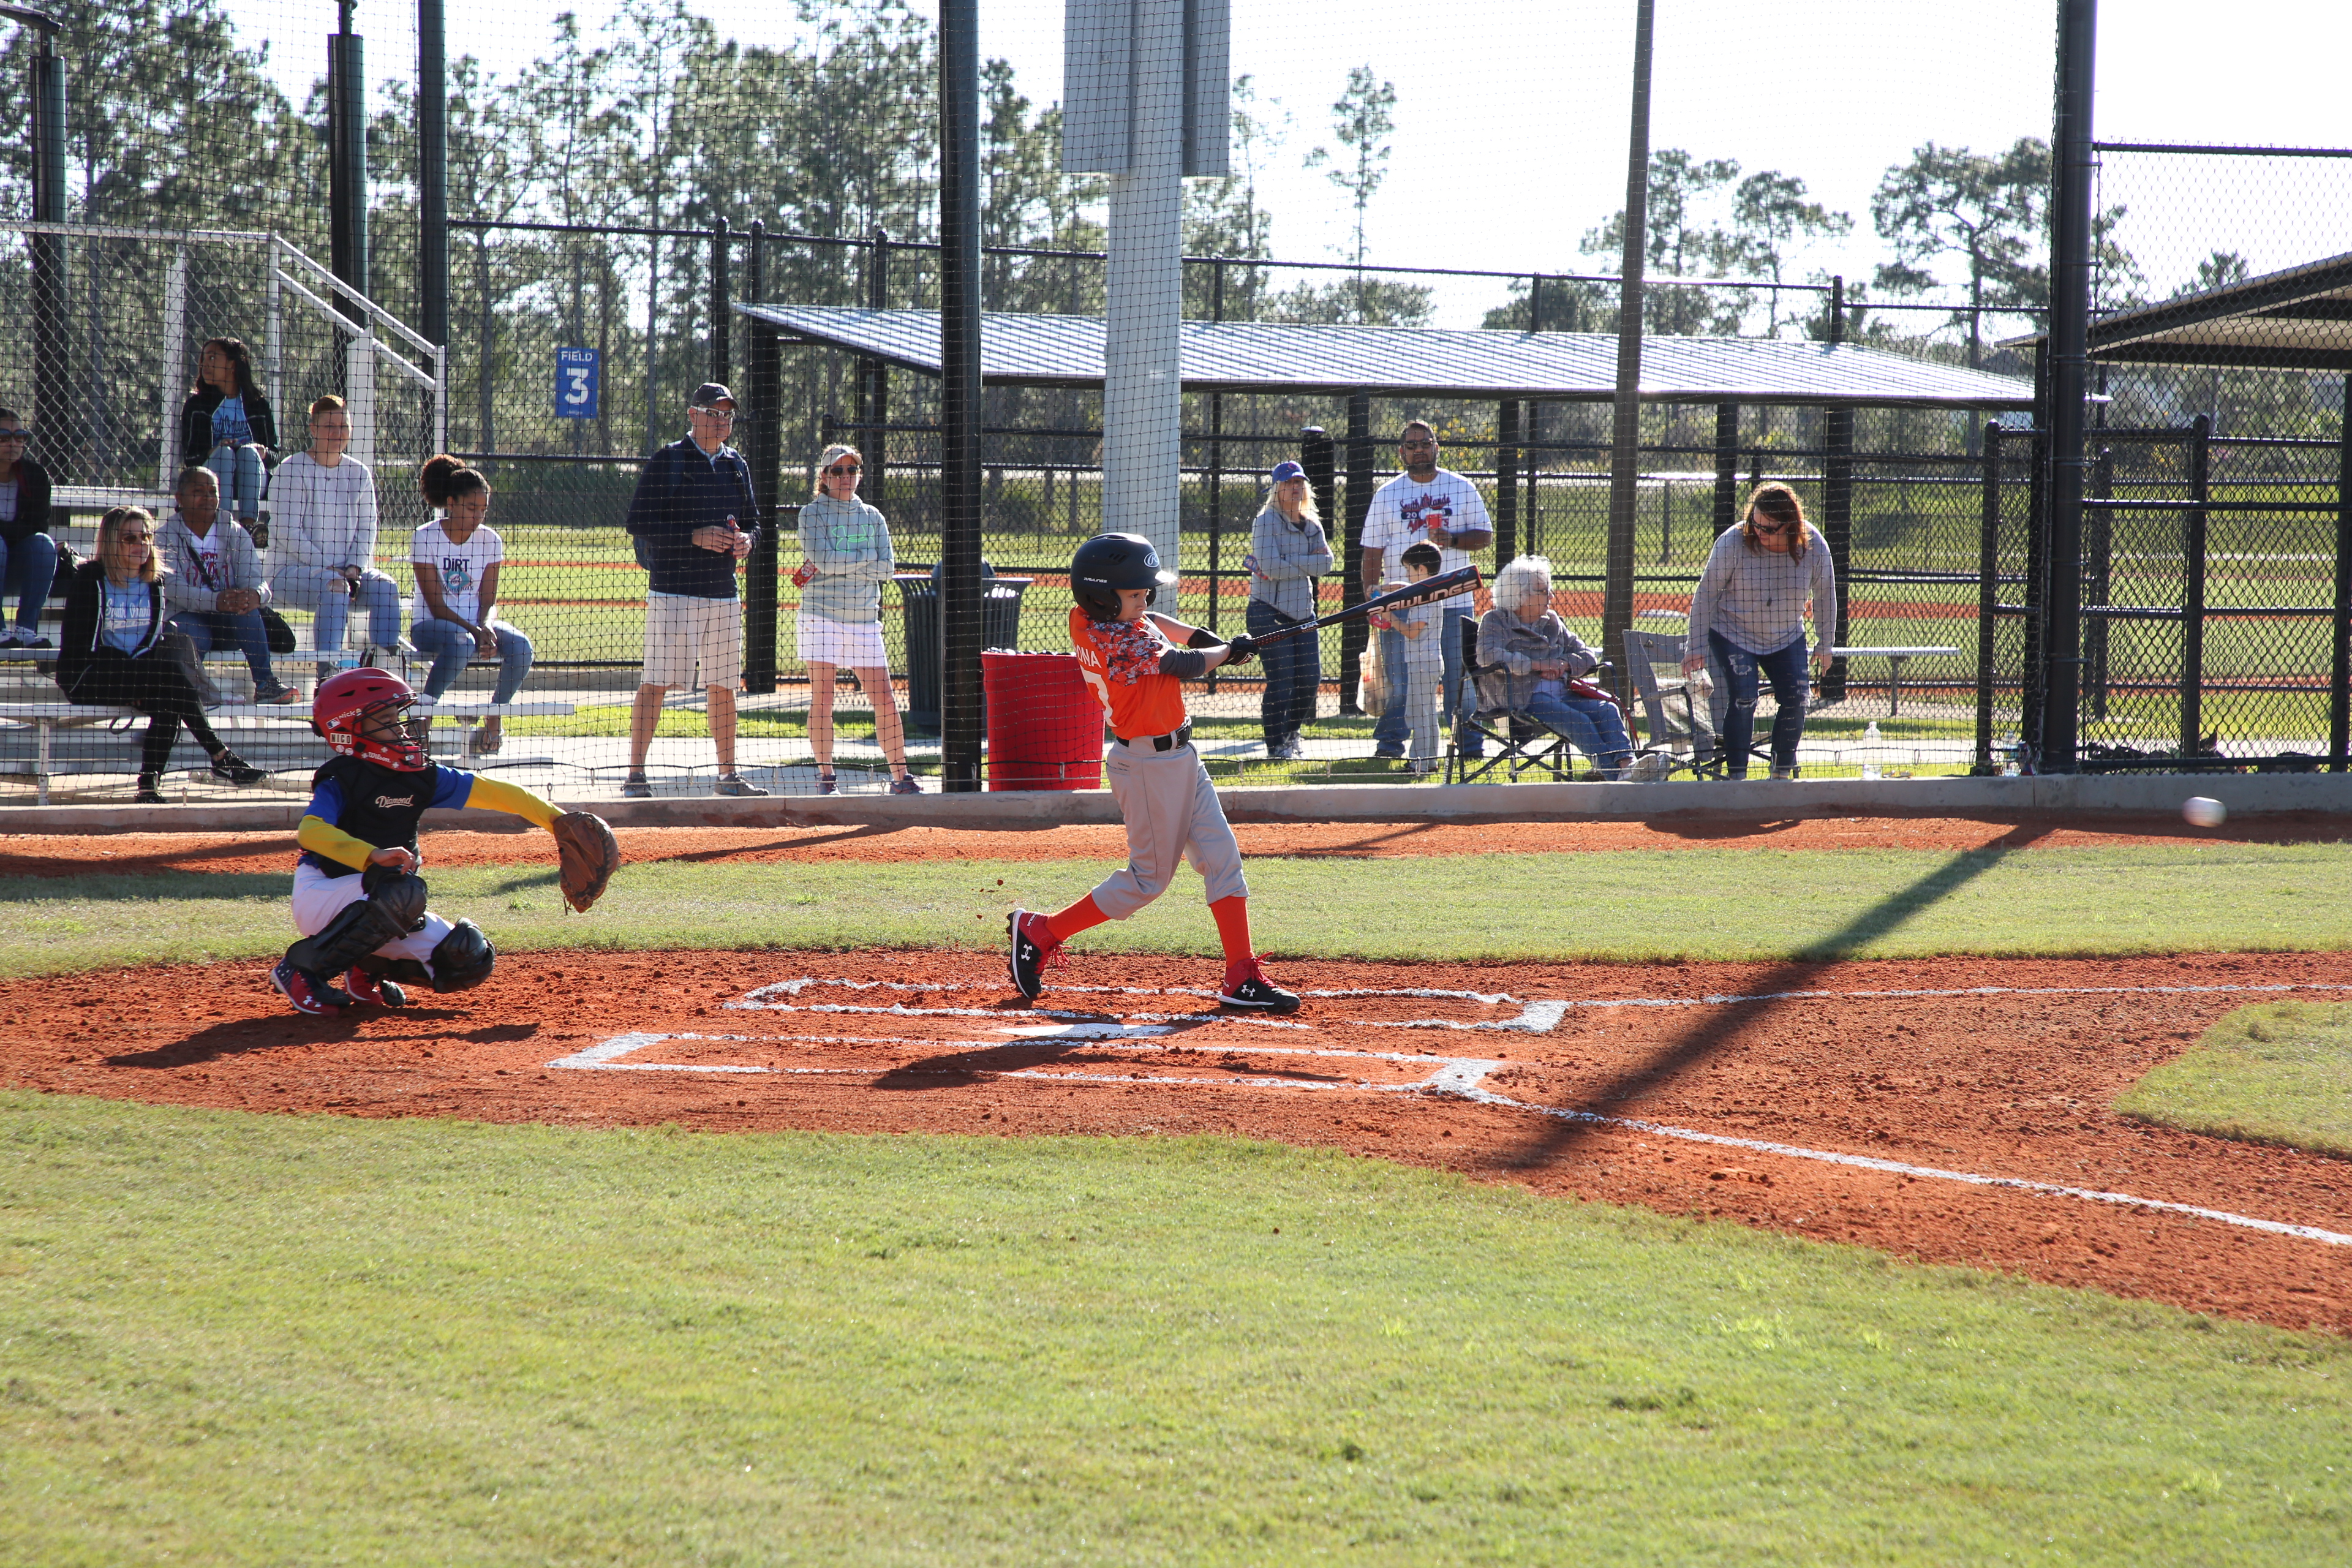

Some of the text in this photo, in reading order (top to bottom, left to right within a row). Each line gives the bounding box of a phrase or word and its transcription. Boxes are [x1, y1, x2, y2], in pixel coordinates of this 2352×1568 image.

[560, 350, 593, 362] FIELD
[565, 368, 589, 405] 3
[1366, 578, 1478, 617] RAWLINGS
[105, 598, 151, 620] South Orland
[1075, 644, 1102, 668] ONA
[331, 734, 351, 744] NICO
[375, 794, 414, 808] Diamond
